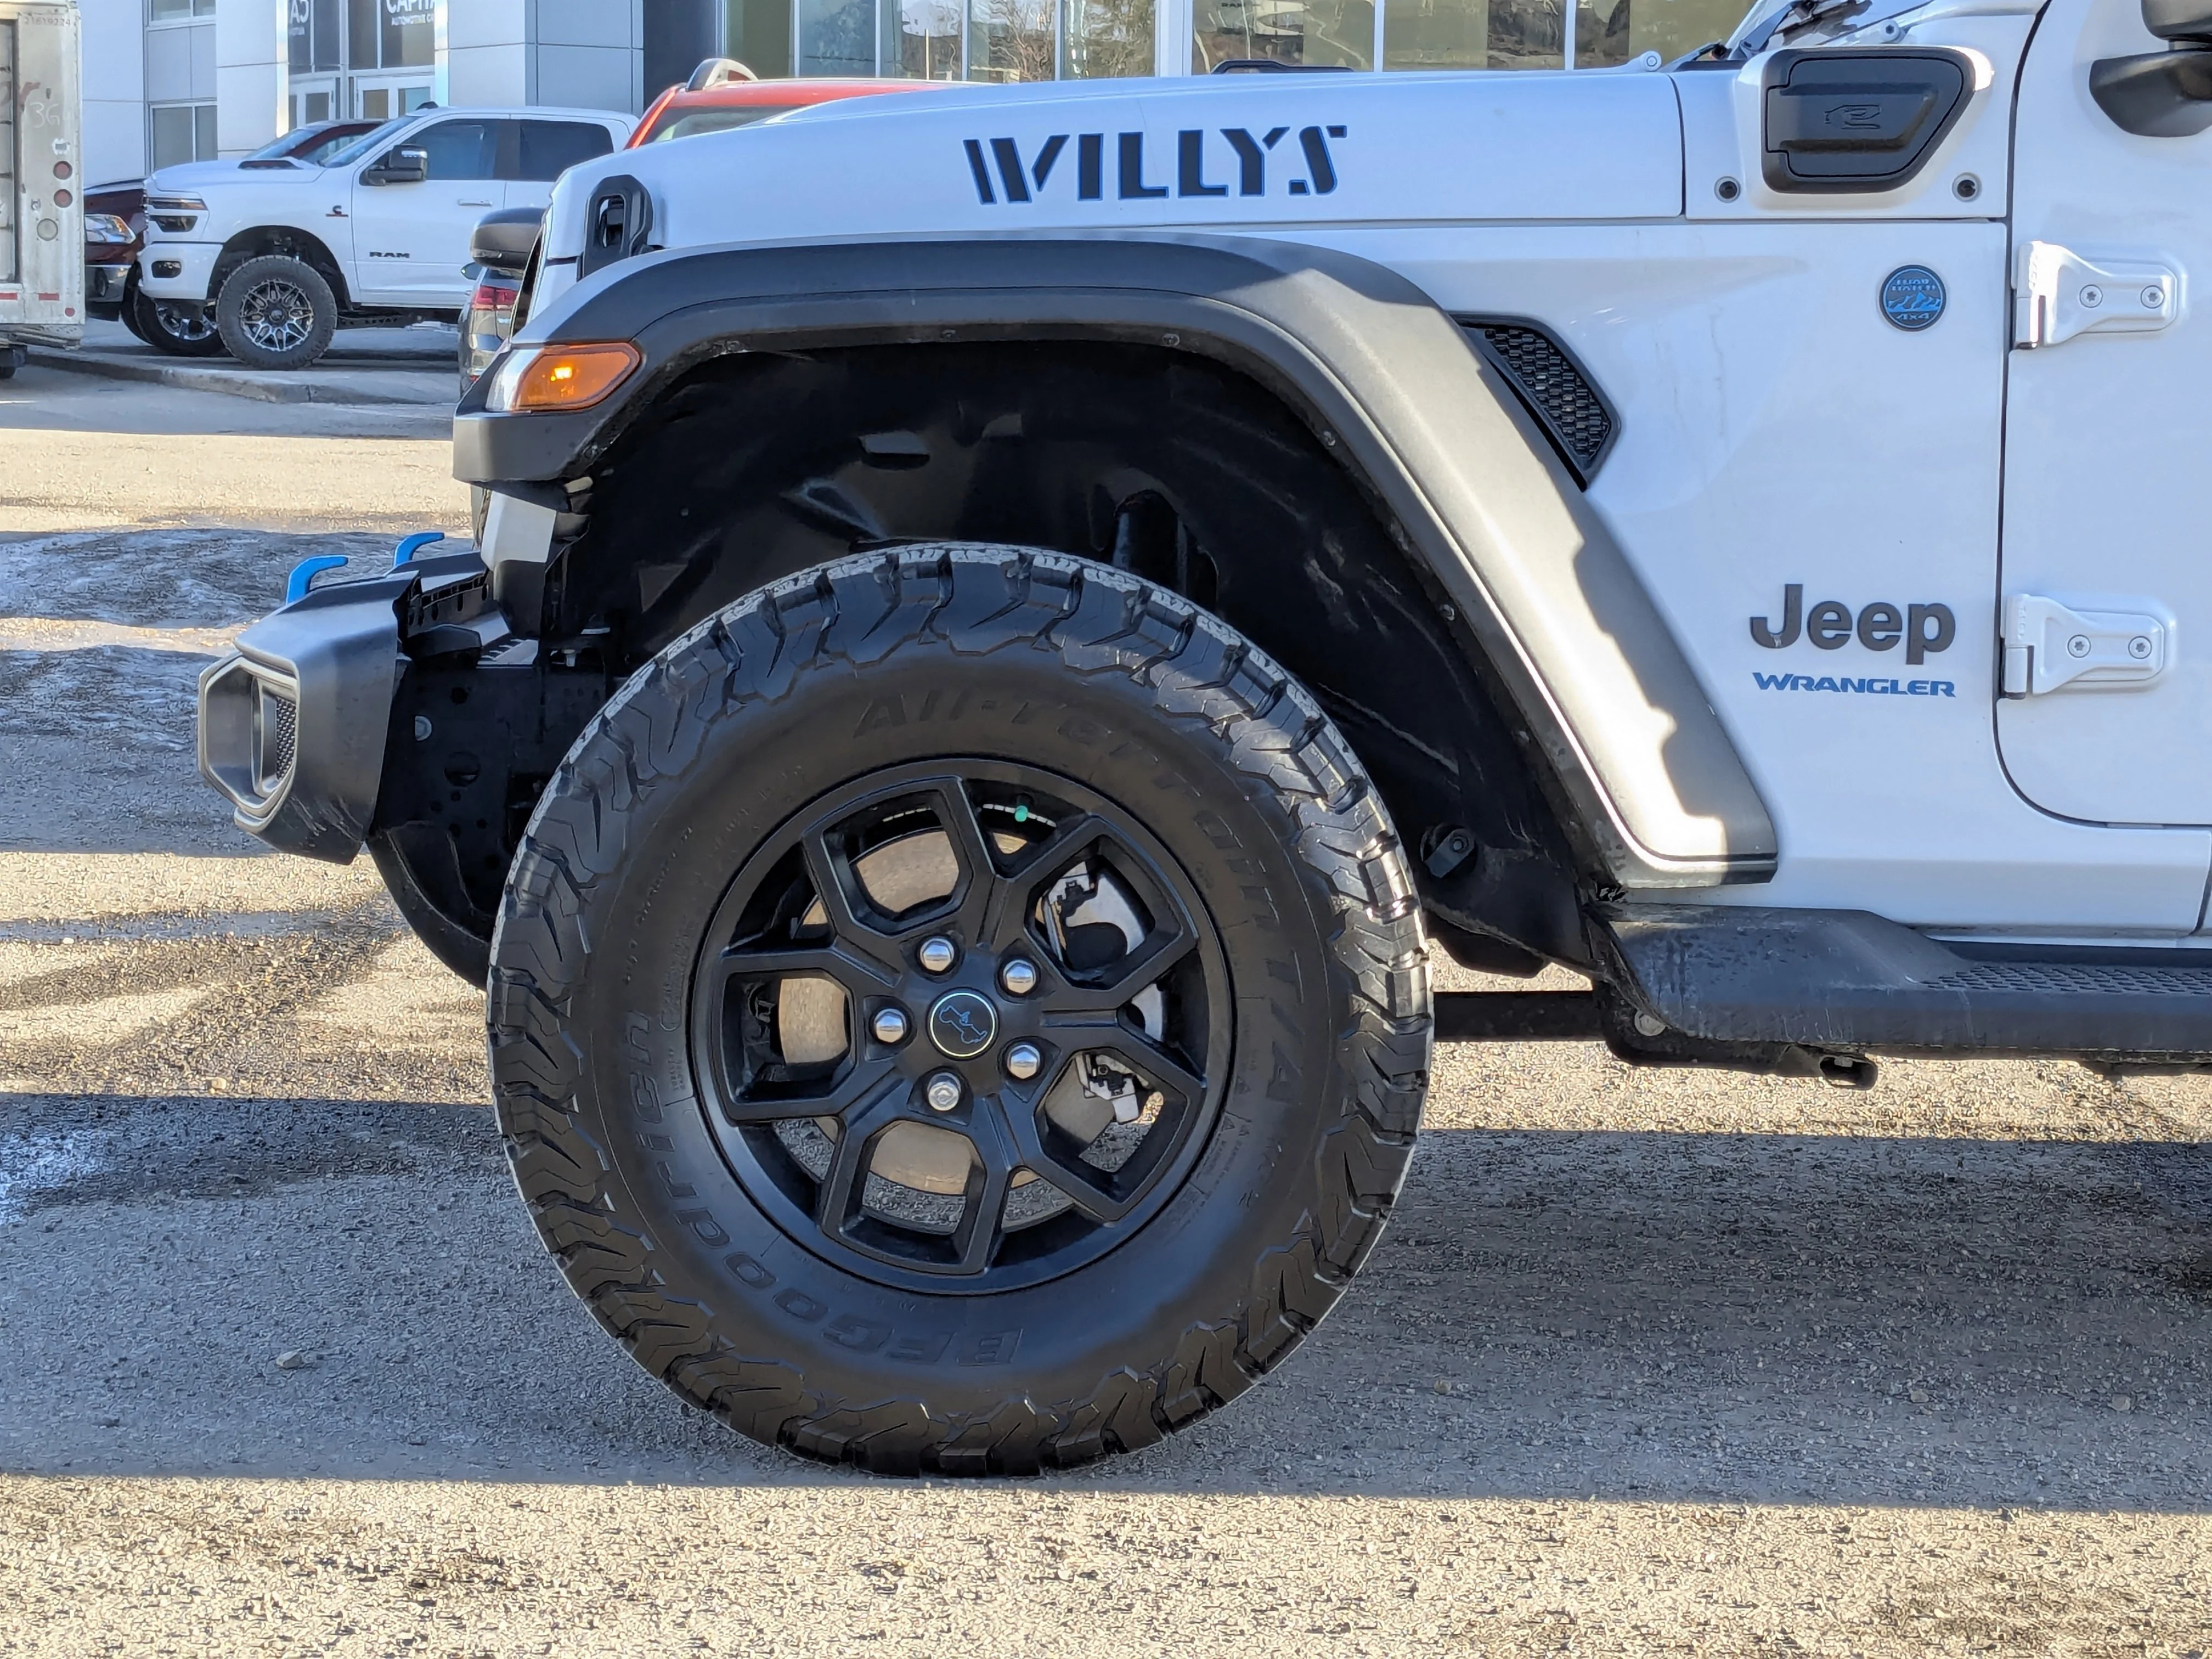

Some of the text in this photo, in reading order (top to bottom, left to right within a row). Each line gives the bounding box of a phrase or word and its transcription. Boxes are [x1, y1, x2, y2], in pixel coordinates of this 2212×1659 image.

[963, 125, 1347, 205] WILLYS
[1750, 584, 1956, 665] Jeep
[1752, 672, 1956, 697] WRANGLER
[625, 1010, 1023, 1367] BFGoodrich
